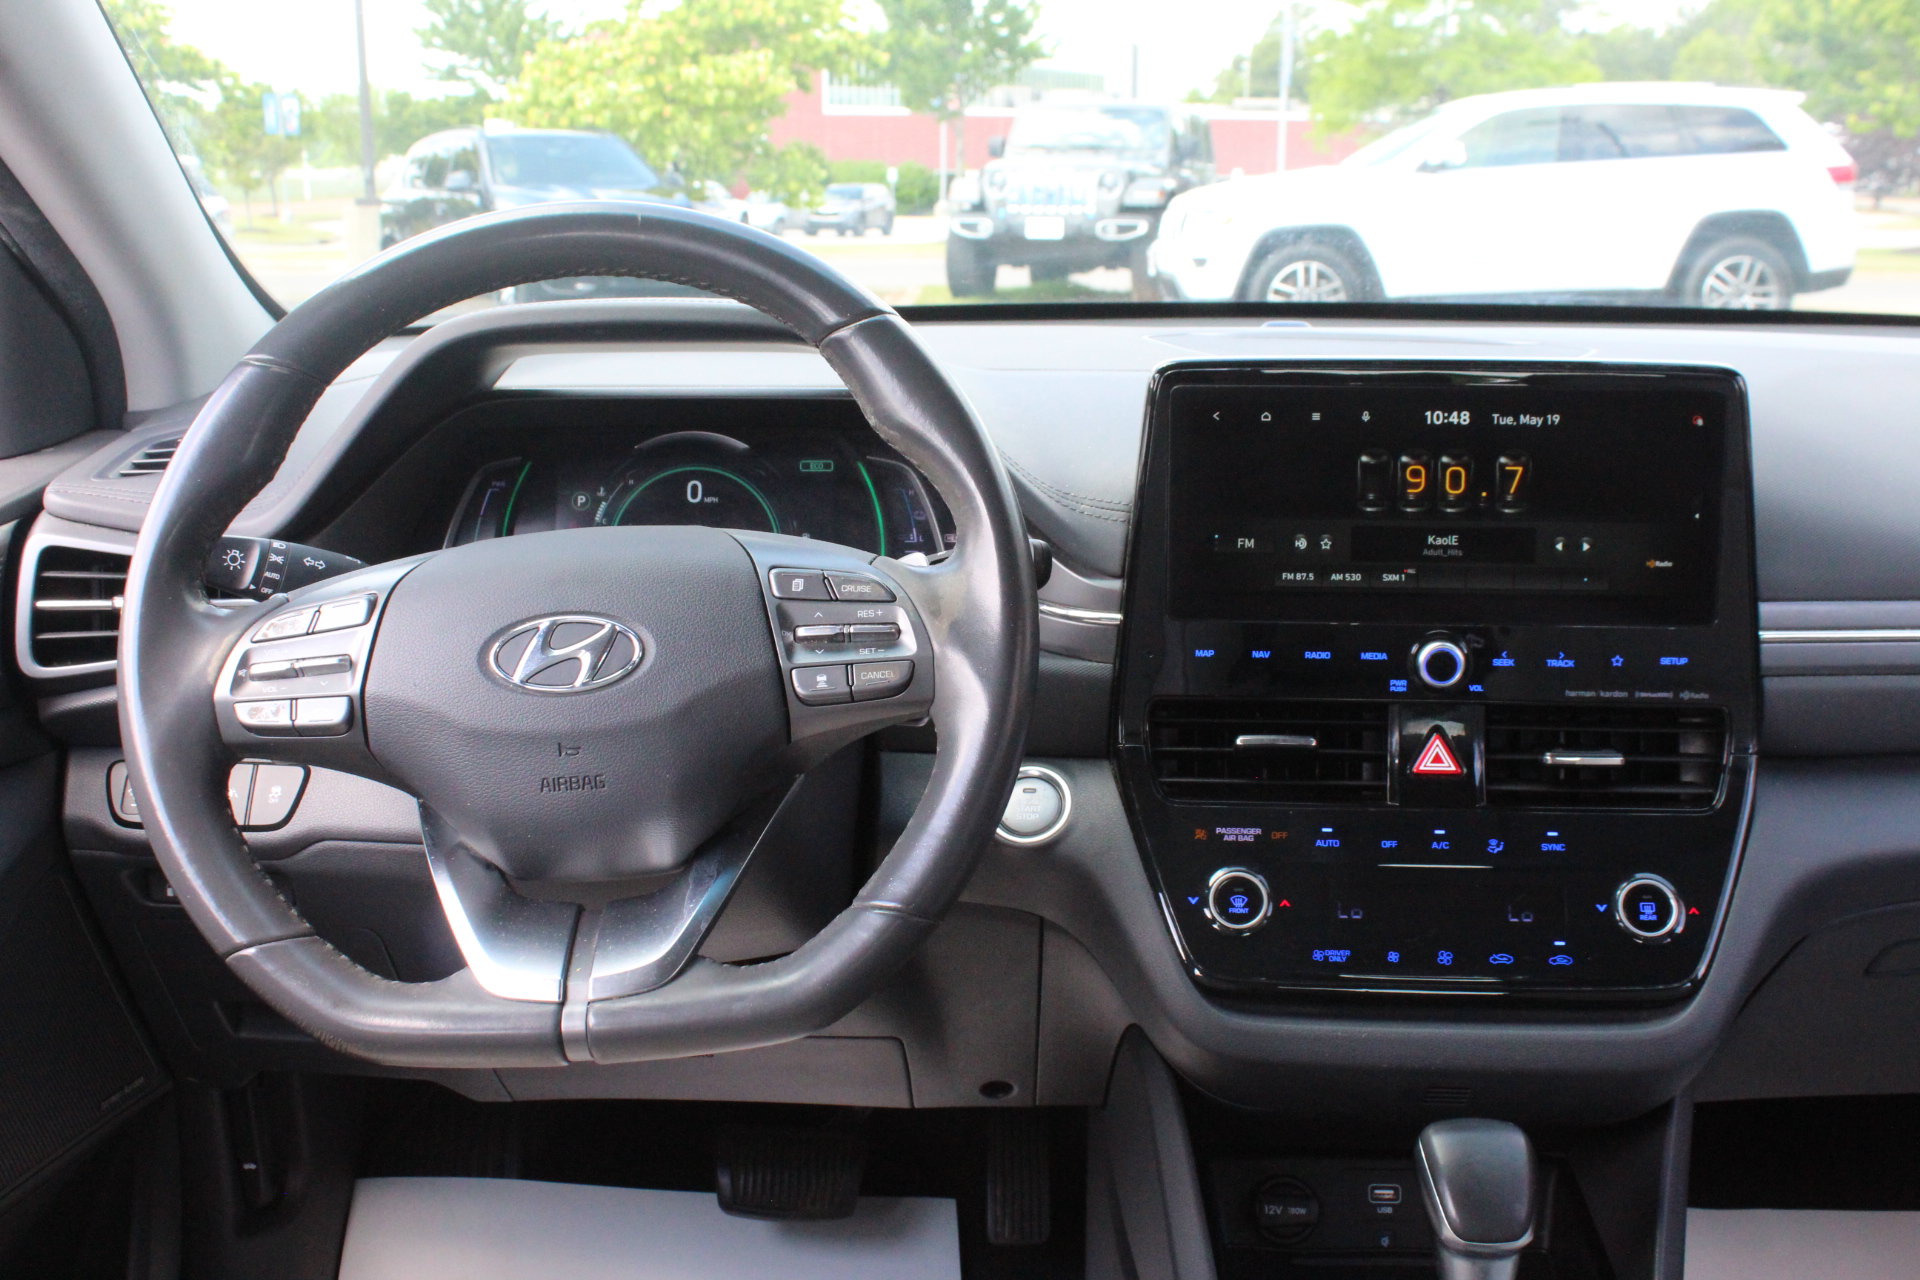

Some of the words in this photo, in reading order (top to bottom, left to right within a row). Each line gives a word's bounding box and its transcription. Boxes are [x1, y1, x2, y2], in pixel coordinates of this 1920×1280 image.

[1424, 410, 1471, 425] 10:48
[1491, 413, 1517, 426] Tue,
[1519, 413, 1544, 428] May
[1546, 414, 1561, 425] 19
[686, 479, 703, 504] 0
[576, 495, 586, 507] P
[1237, 538, 1255, 549] FM
[264, 571, 281, 580] AUTO
[1282, 573, 1294, 581] FM
[1295, 573, 1315, 581] 87.5
[1330, 573, 1343, 582] AM
[1344, 574, 1362, 582] 530
[1382, 574, 1400, 582] SXM
[840, 584, 872, 593] CRUISE
[857, 610, 875, 618] RES
[859, 647, 877, 655] SET
[1194, 649, 1215, 658] MAP
[1251, 650, 1271, 659] NAV
[1304, 651, 1331, 660] RADIO
[1360, 652, 1388, 661] MEDIA
[1492, 658, 1515, 667] SEEK
[1546, 659, 1575, 668] TRACK
[1659, 657, 1689, 666] SETUP
[860, 670, 896, 680] CANCEL
[1389, 679, 1408, 687] PWR
[1468, 684, 1484, 692] VOL
[540, 774, 606, 793] AIRBAG
[1215, 827, 1262, 835] PASSENGER
[1271, 831, 1289, 840] OFF
[1237, 834, 1255, 842] BAG
[1315, 839, 1340, 848] AUTO
[1381, 840, 1398, 848] OFF
[1431, 841, 1450, 850] A/C
[1540, 843, 1566, 851] SYNC
[1264, 1204, 1283, 1215] 12V
[1376, 1206, 1393, 1214] USB
